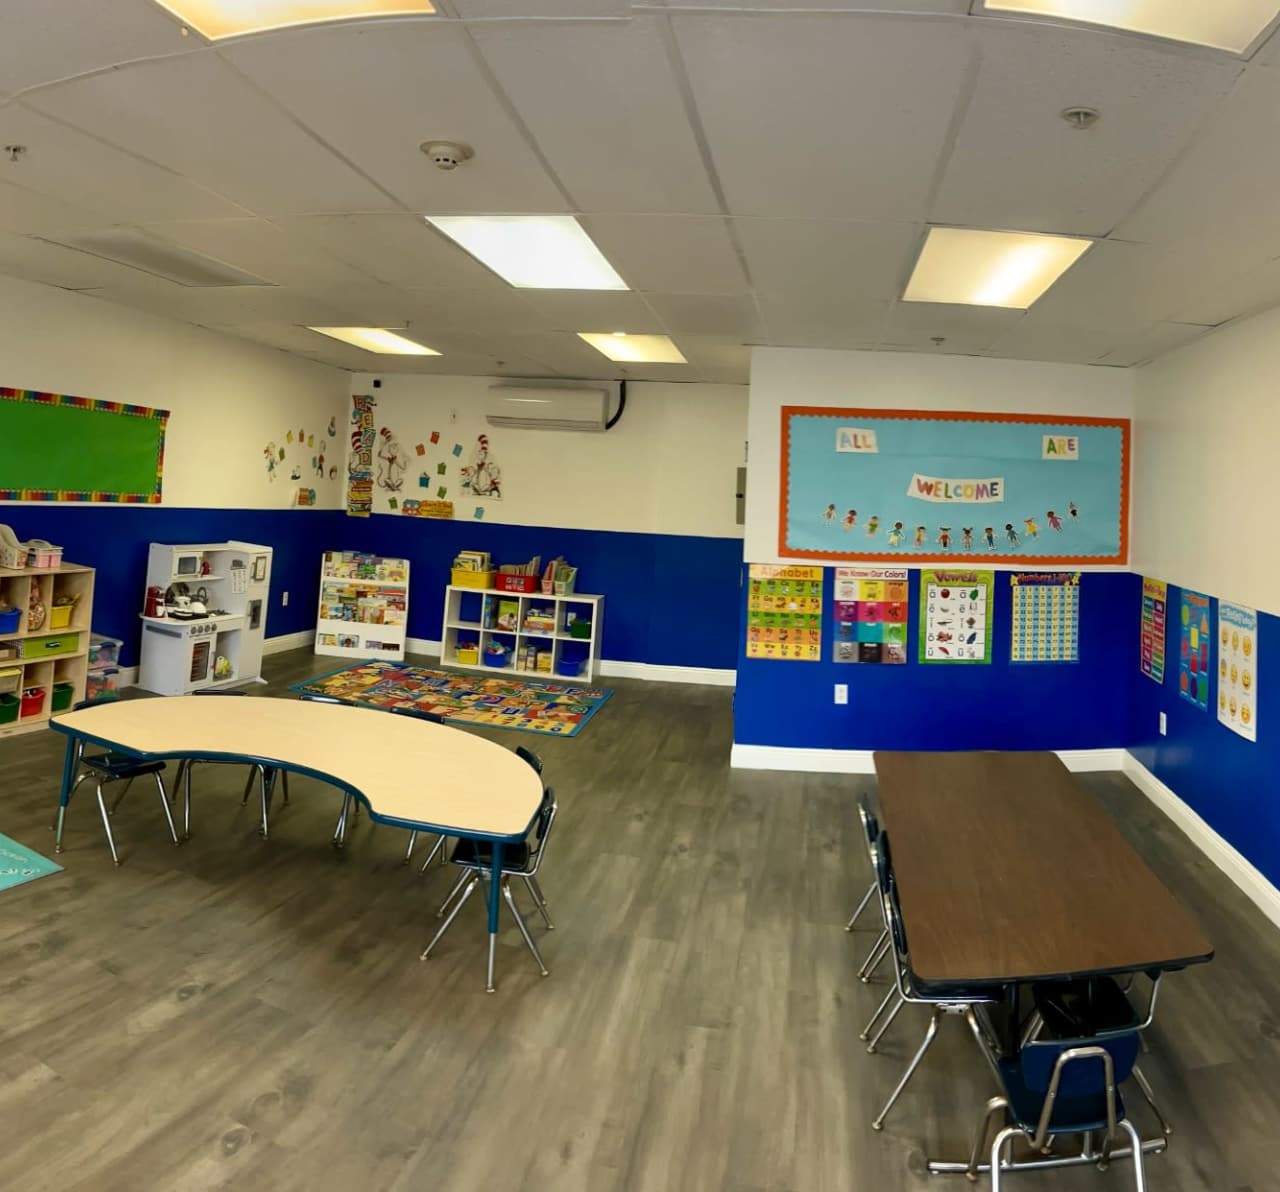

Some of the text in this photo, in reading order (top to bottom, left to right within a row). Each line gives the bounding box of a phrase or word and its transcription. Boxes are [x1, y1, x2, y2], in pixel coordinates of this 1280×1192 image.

[840, 432, 1076, 455] ALL ARE
[916, 478, 1000, 500] WELCOME
